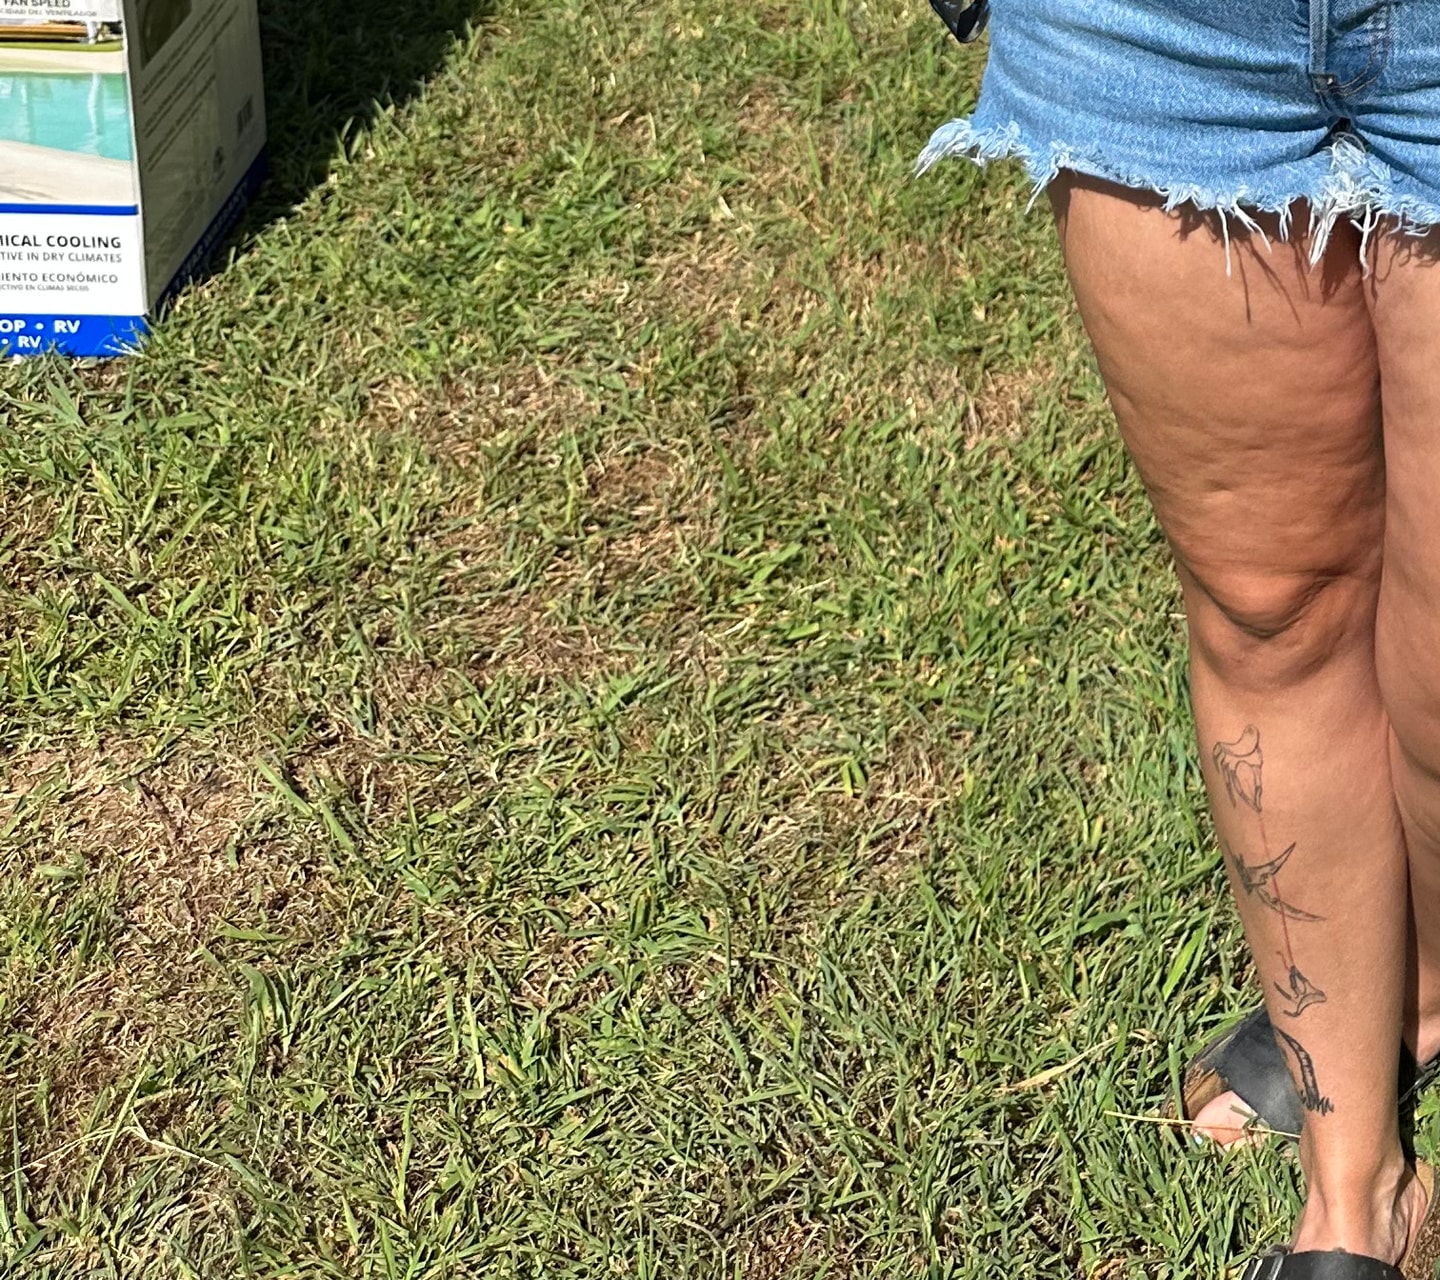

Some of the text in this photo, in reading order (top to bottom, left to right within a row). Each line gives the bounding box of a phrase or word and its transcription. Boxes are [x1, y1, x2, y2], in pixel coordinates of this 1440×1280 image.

[0, 234, 121, 249] ICAL COOLING
[27, 251, 39, 261] IN
[42, 252, 64, 261] DRY
[68, 252, 122, 263] CLIMATES
[1, 271, 118, 283] IENTO ECONÓMICO
[54, 319, 80, 334] RV
[18, 335, 41, 348] RV
